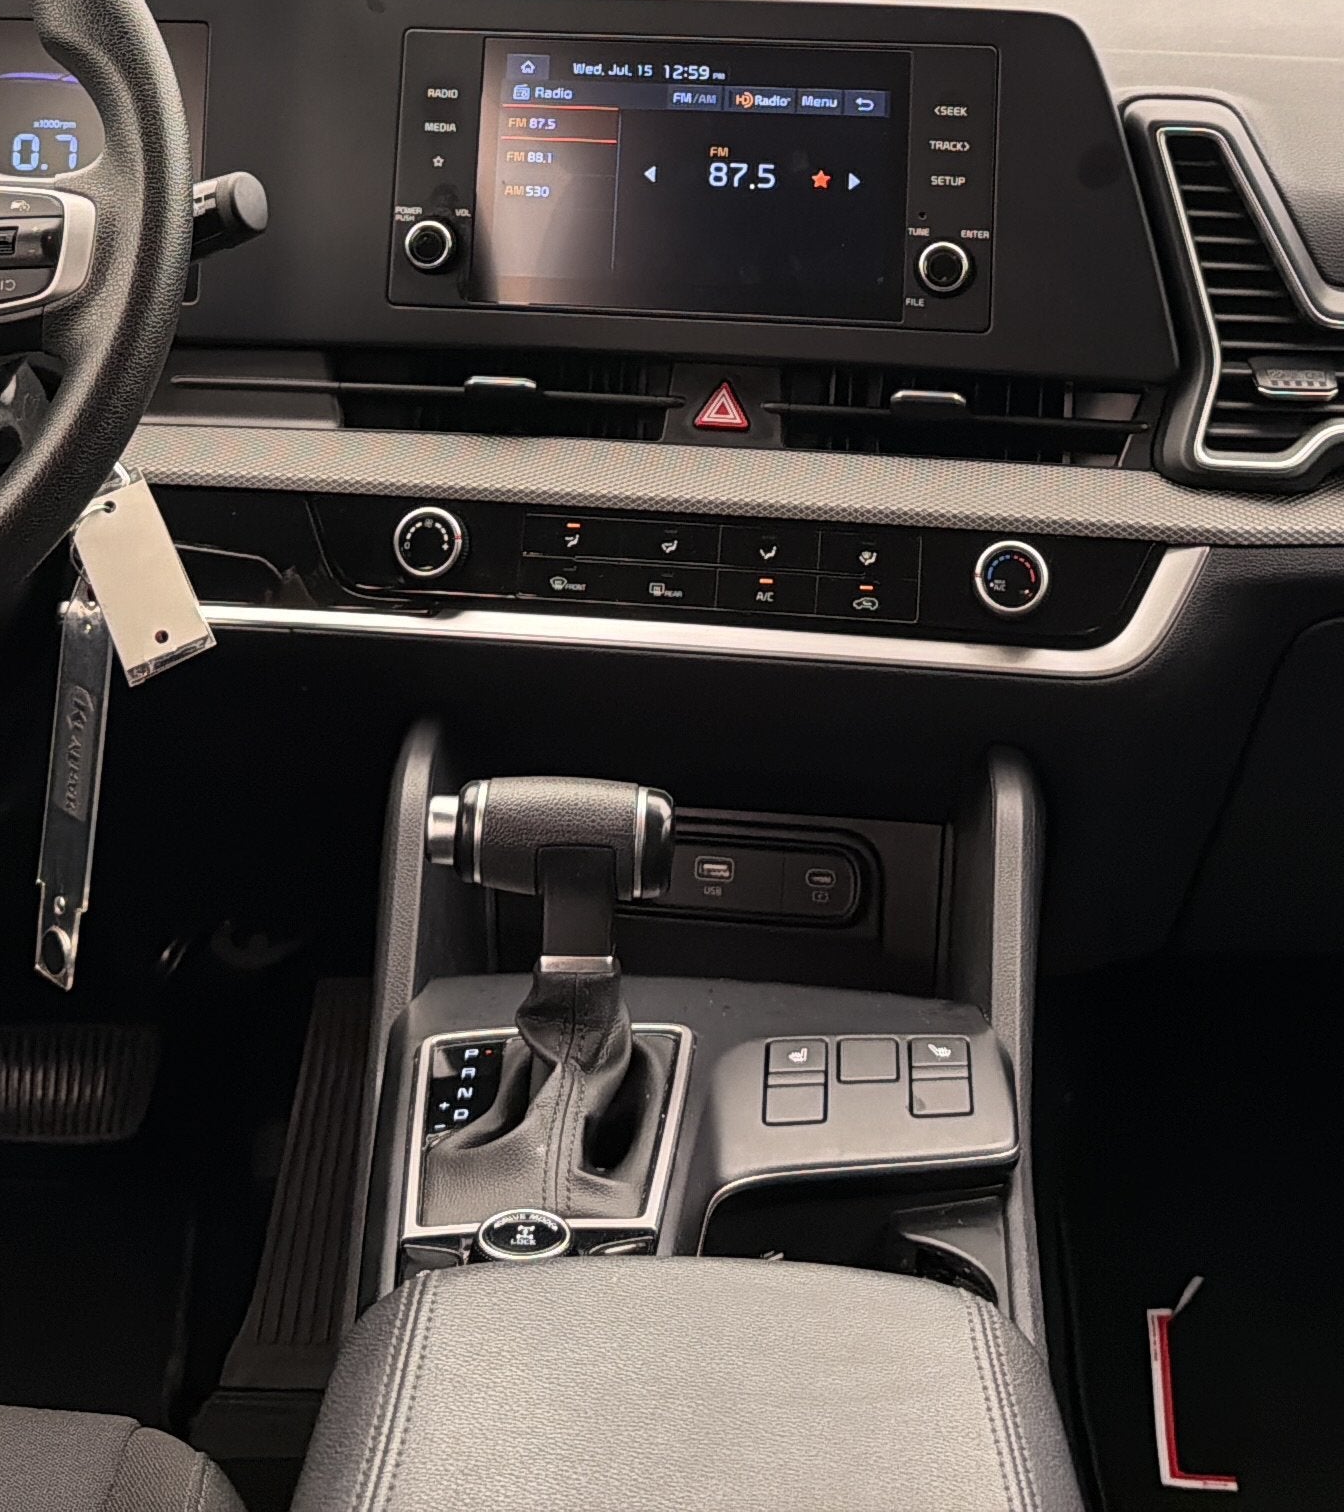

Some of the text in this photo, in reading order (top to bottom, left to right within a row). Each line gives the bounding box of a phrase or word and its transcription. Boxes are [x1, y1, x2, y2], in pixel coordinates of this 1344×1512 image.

[637, 64, 653, 77] 15
[663, 64, 711, 81] 12:59
[427, 88, 459, 99] RADIO
[534, 85, 573, 100] Radio
[672, 91, 717, 106] FM/AM
[801, 95, 838, 108] Menu
[424, 122, 457, 133] MEDIA
[508, 117, 557, 131] FM 87.5
[12, 133, 78, 171] 0.7
[506, 150, 553, 164] FM 88.1
[710, 145, 729, 159] FM
[709, 162, 776, 190] 87.5
[930, 175, 966, 187] SETUP
[504, 184, 550, 199] AM 530
[455, 208, 472, 218] VOL
[908, 227, 930, 237] TUNE
[961, 229, 990, 240] ENTER
[906, 297, 925, 308] FILE
[755, 591, 775, 602] A/C
[464, 1048, 479, 1061] P
[457, 1086, 473, 1100] N
[453, 1108, 469, 1122] D
